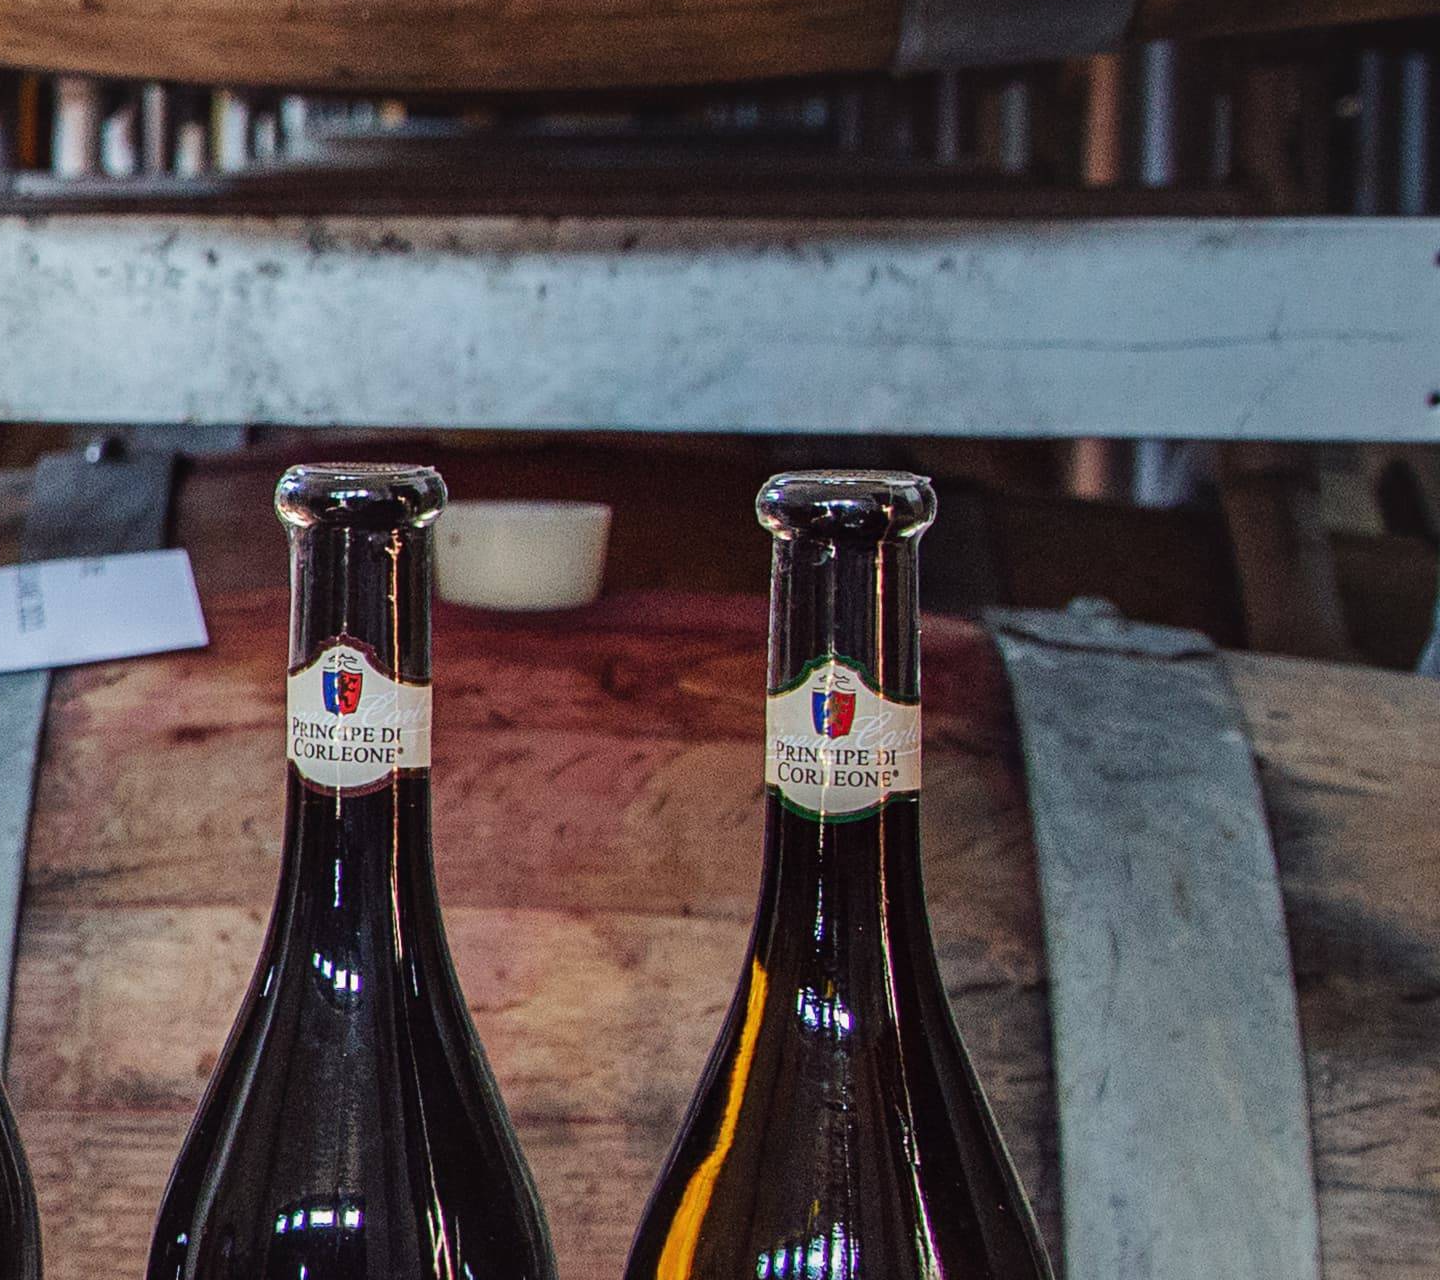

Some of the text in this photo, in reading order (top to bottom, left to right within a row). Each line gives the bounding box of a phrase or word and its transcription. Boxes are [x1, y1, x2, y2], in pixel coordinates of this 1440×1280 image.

[381, 727, 402, 743] DI
[776, 739, 896, 766] PRINIPE DI
